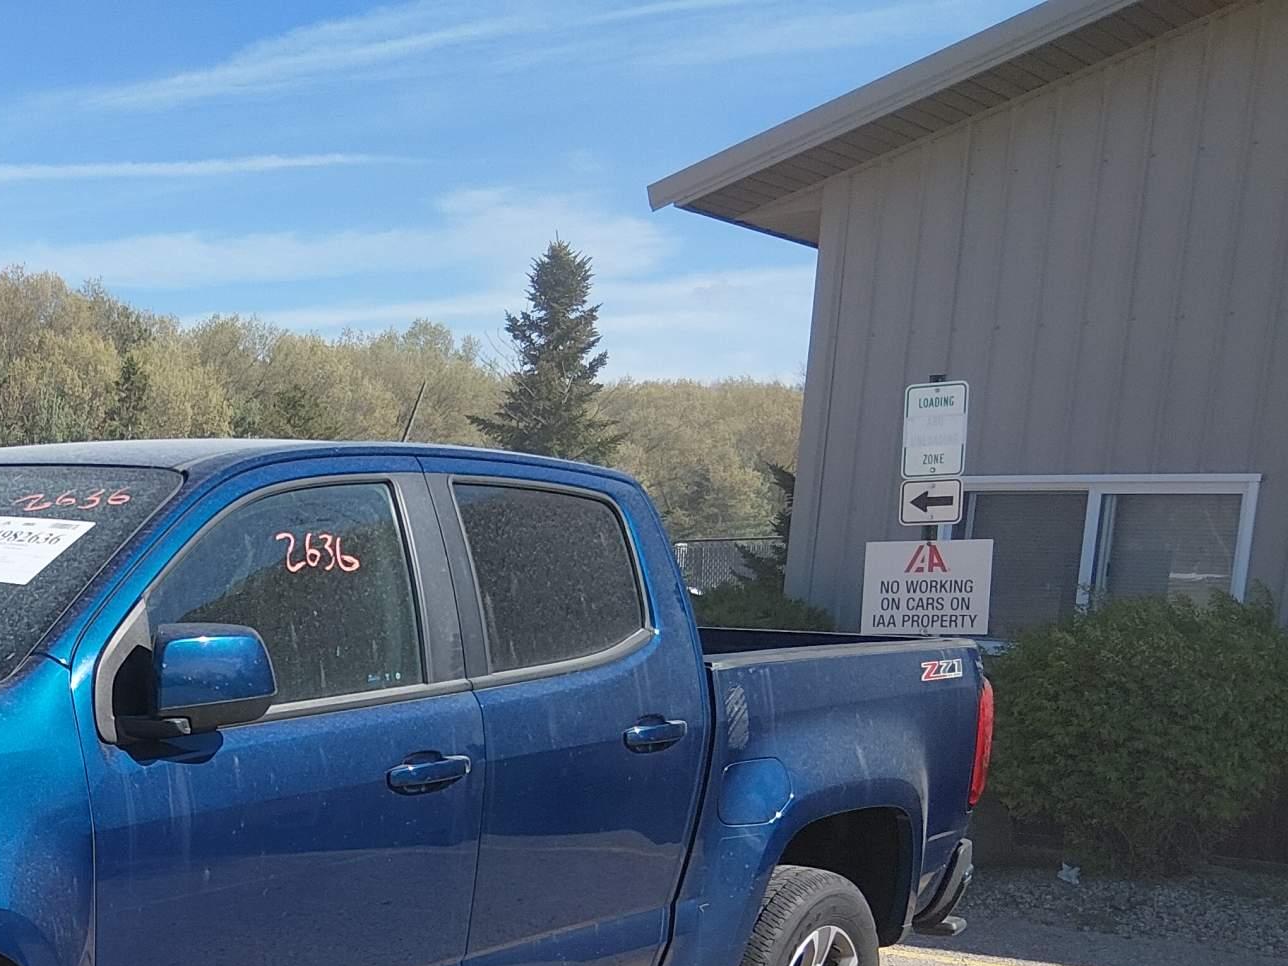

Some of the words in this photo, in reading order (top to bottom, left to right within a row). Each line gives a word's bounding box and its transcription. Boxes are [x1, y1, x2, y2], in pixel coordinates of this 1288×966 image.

[918, 396, 955, 409] LOADING
[922, 453, 945, 465] ZONE
[275, 532, 361, 573] 2636
[880, 580, 900, 594] NO
[905, 579, 975, 594] WORKING
[880, 597, 901, 611] ON
[906, 597, 945, 611] CARS
[950, 597, 971, 611] ON
[872, 614, 897, 628] IAA
[901, 614, 978, 629] PROPERTY
[920, 658, 963, 681] Z71
